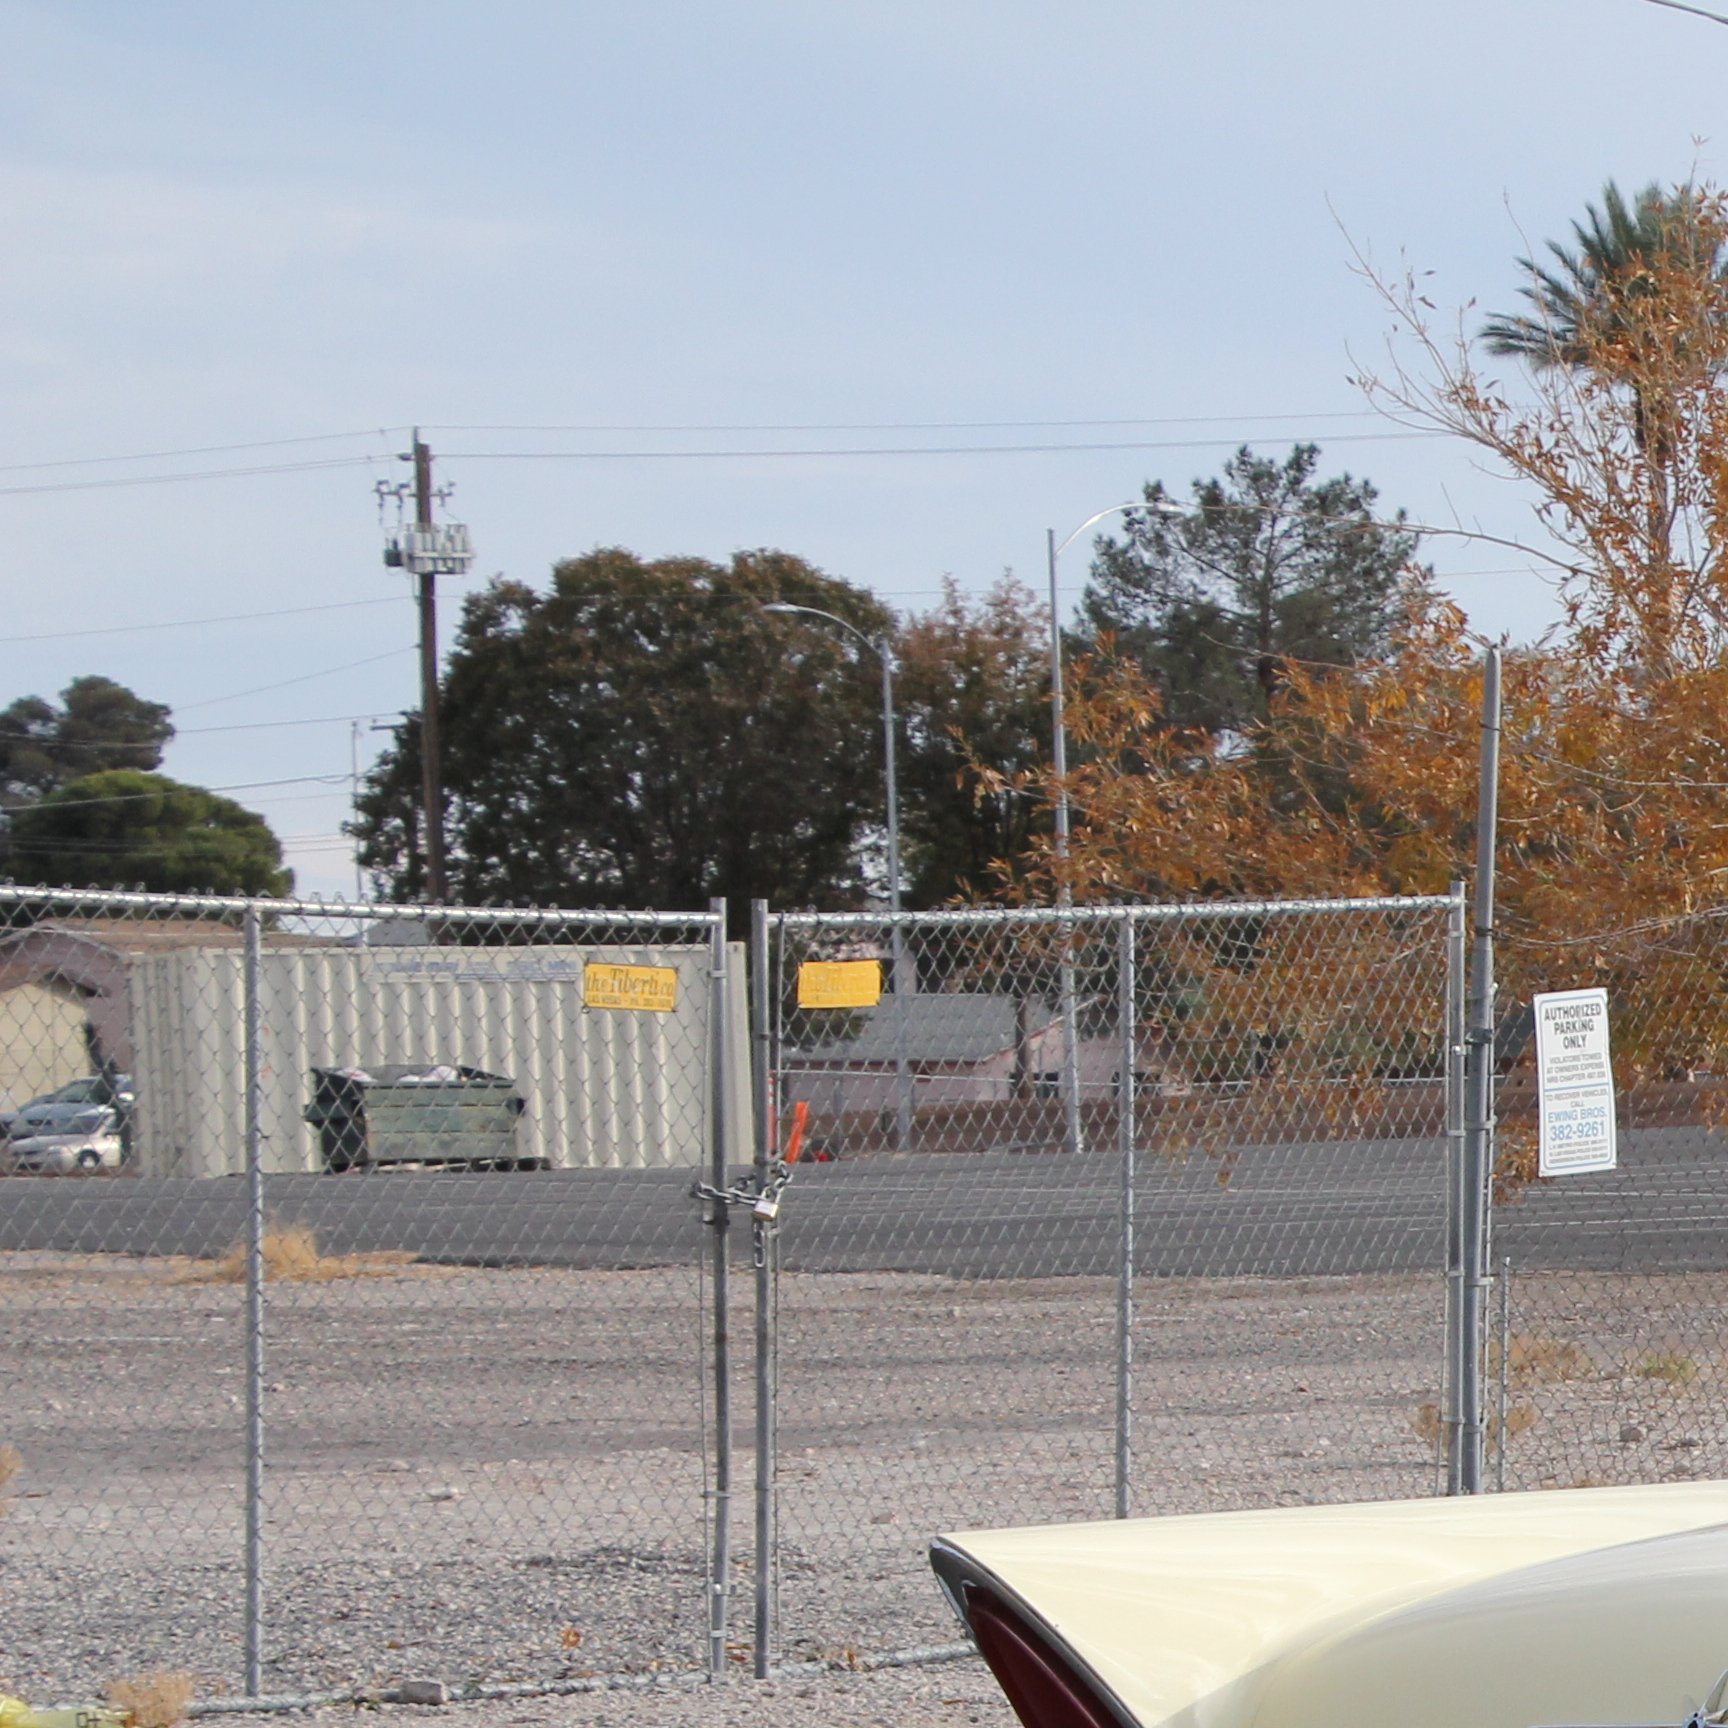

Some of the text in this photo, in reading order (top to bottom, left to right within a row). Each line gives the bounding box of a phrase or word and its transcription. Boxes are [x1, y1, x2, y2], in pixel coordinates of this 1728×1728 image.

[586, 971, 609, 992] the
[1544, 1003, 1601, 1021] AUTHORIZED
[1554, 1018, 1594, 1035] PARKING
[1562, 1035, 1587, 1049] ONLY
[1570, 1100, 1585, 1108] CALL
[1548, 1106, 1607, 1123] EWING BROS.
[1550, 1120, 1605, 1141] 382-9261
